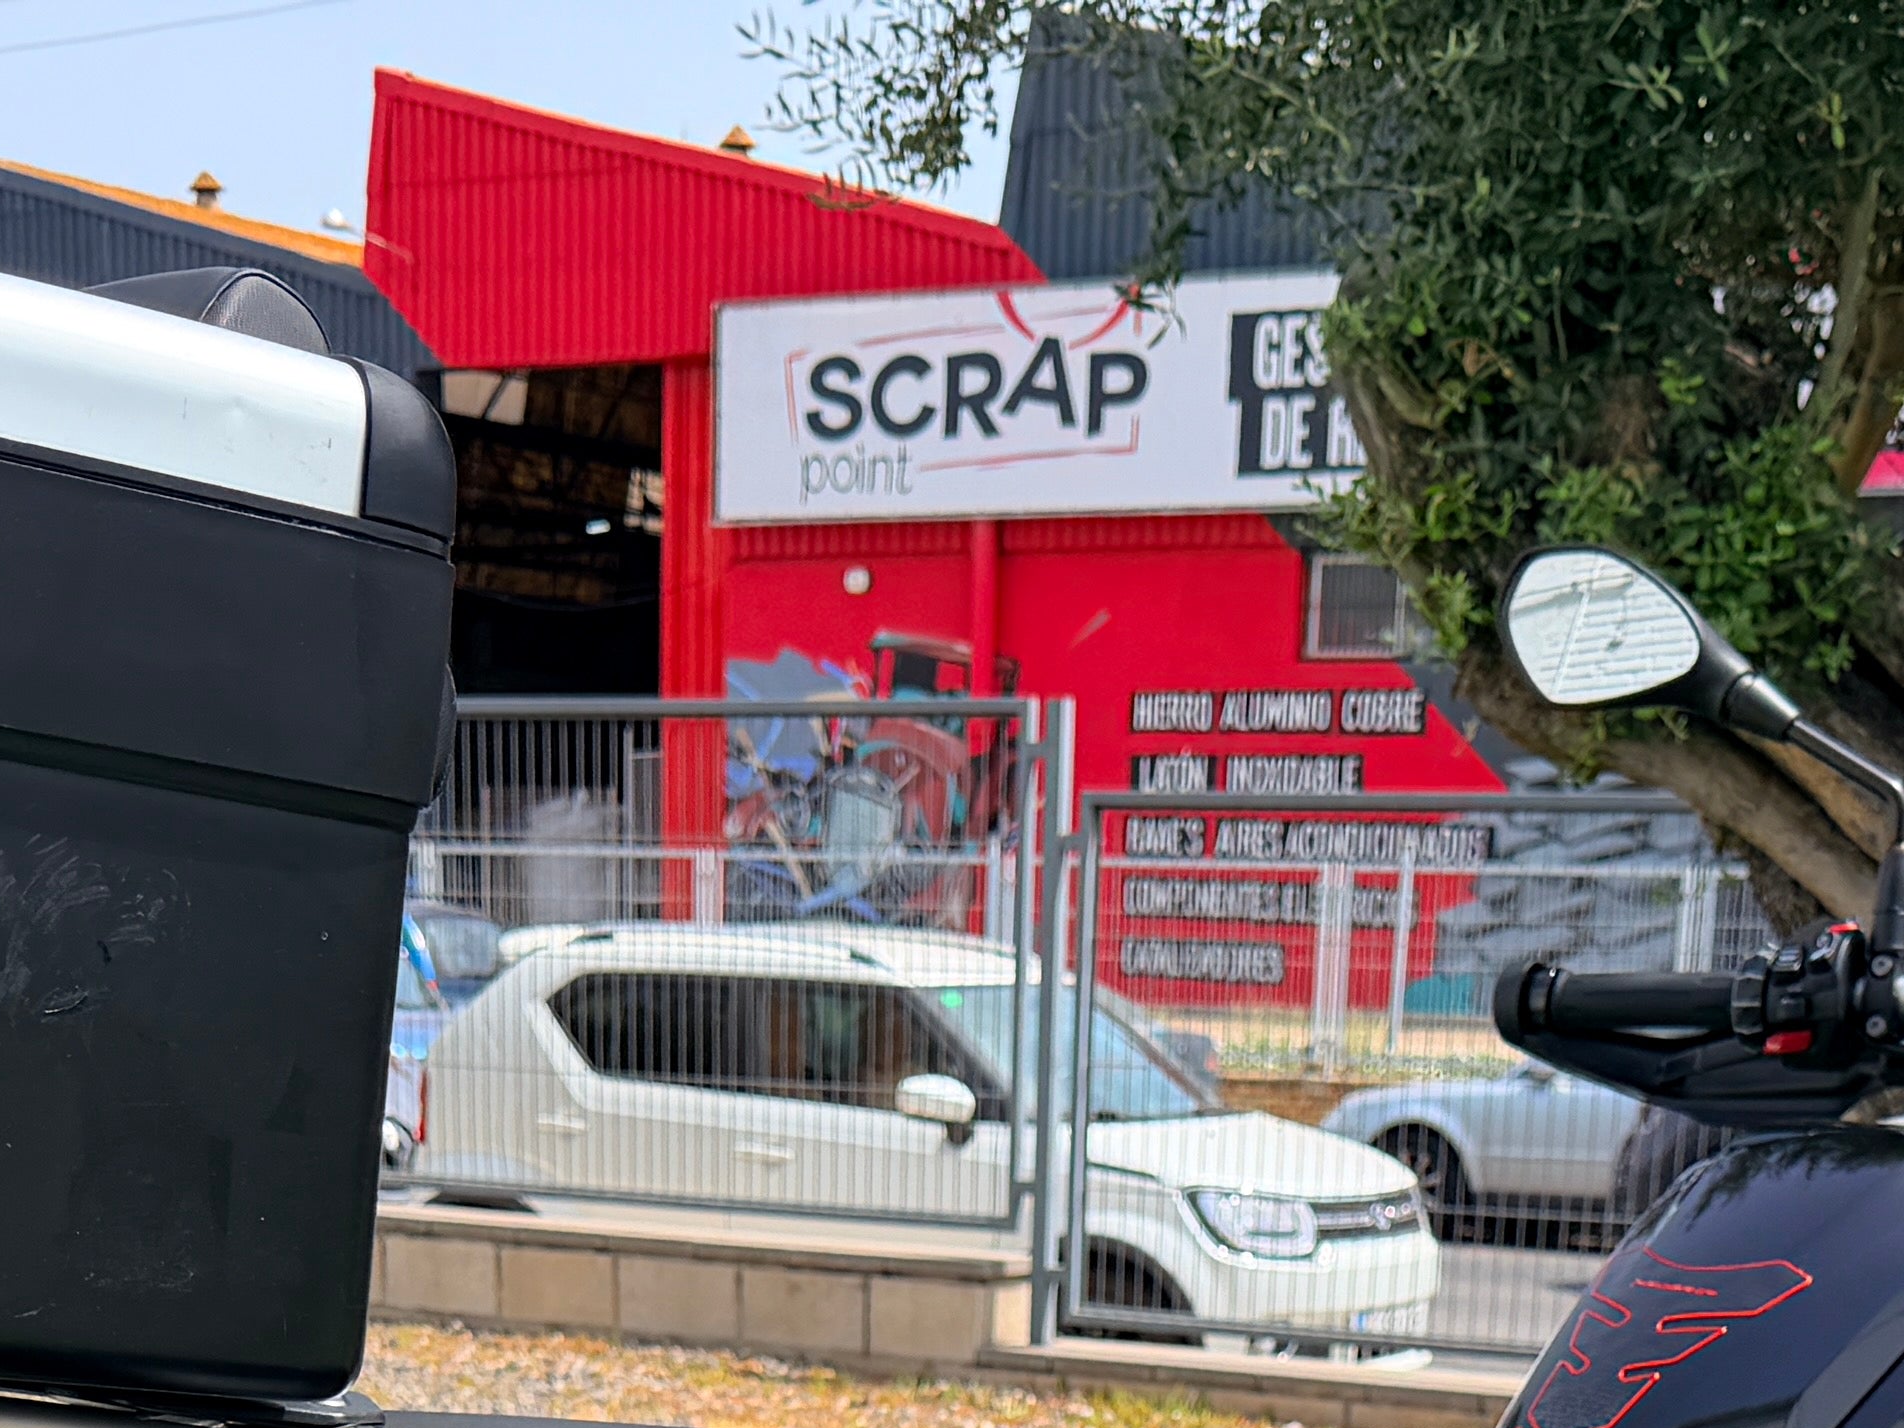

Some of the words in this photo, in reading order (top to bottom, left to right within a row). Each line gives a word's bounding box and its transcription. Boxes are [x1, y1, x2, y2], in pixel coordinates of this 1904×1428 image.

[806, 337, 1148, 440] SCRAP
[1259, 394, 1316, 470] DE
[799, 443, 913, 506] point
[1132, 691, 1213, 732] HIERRO
[1219, 690, 1332, 732] ALUMINIO
[1341, 689, 1424, 734] COBRE
[1226, 754, 1361, 793] INOXIDABLE
